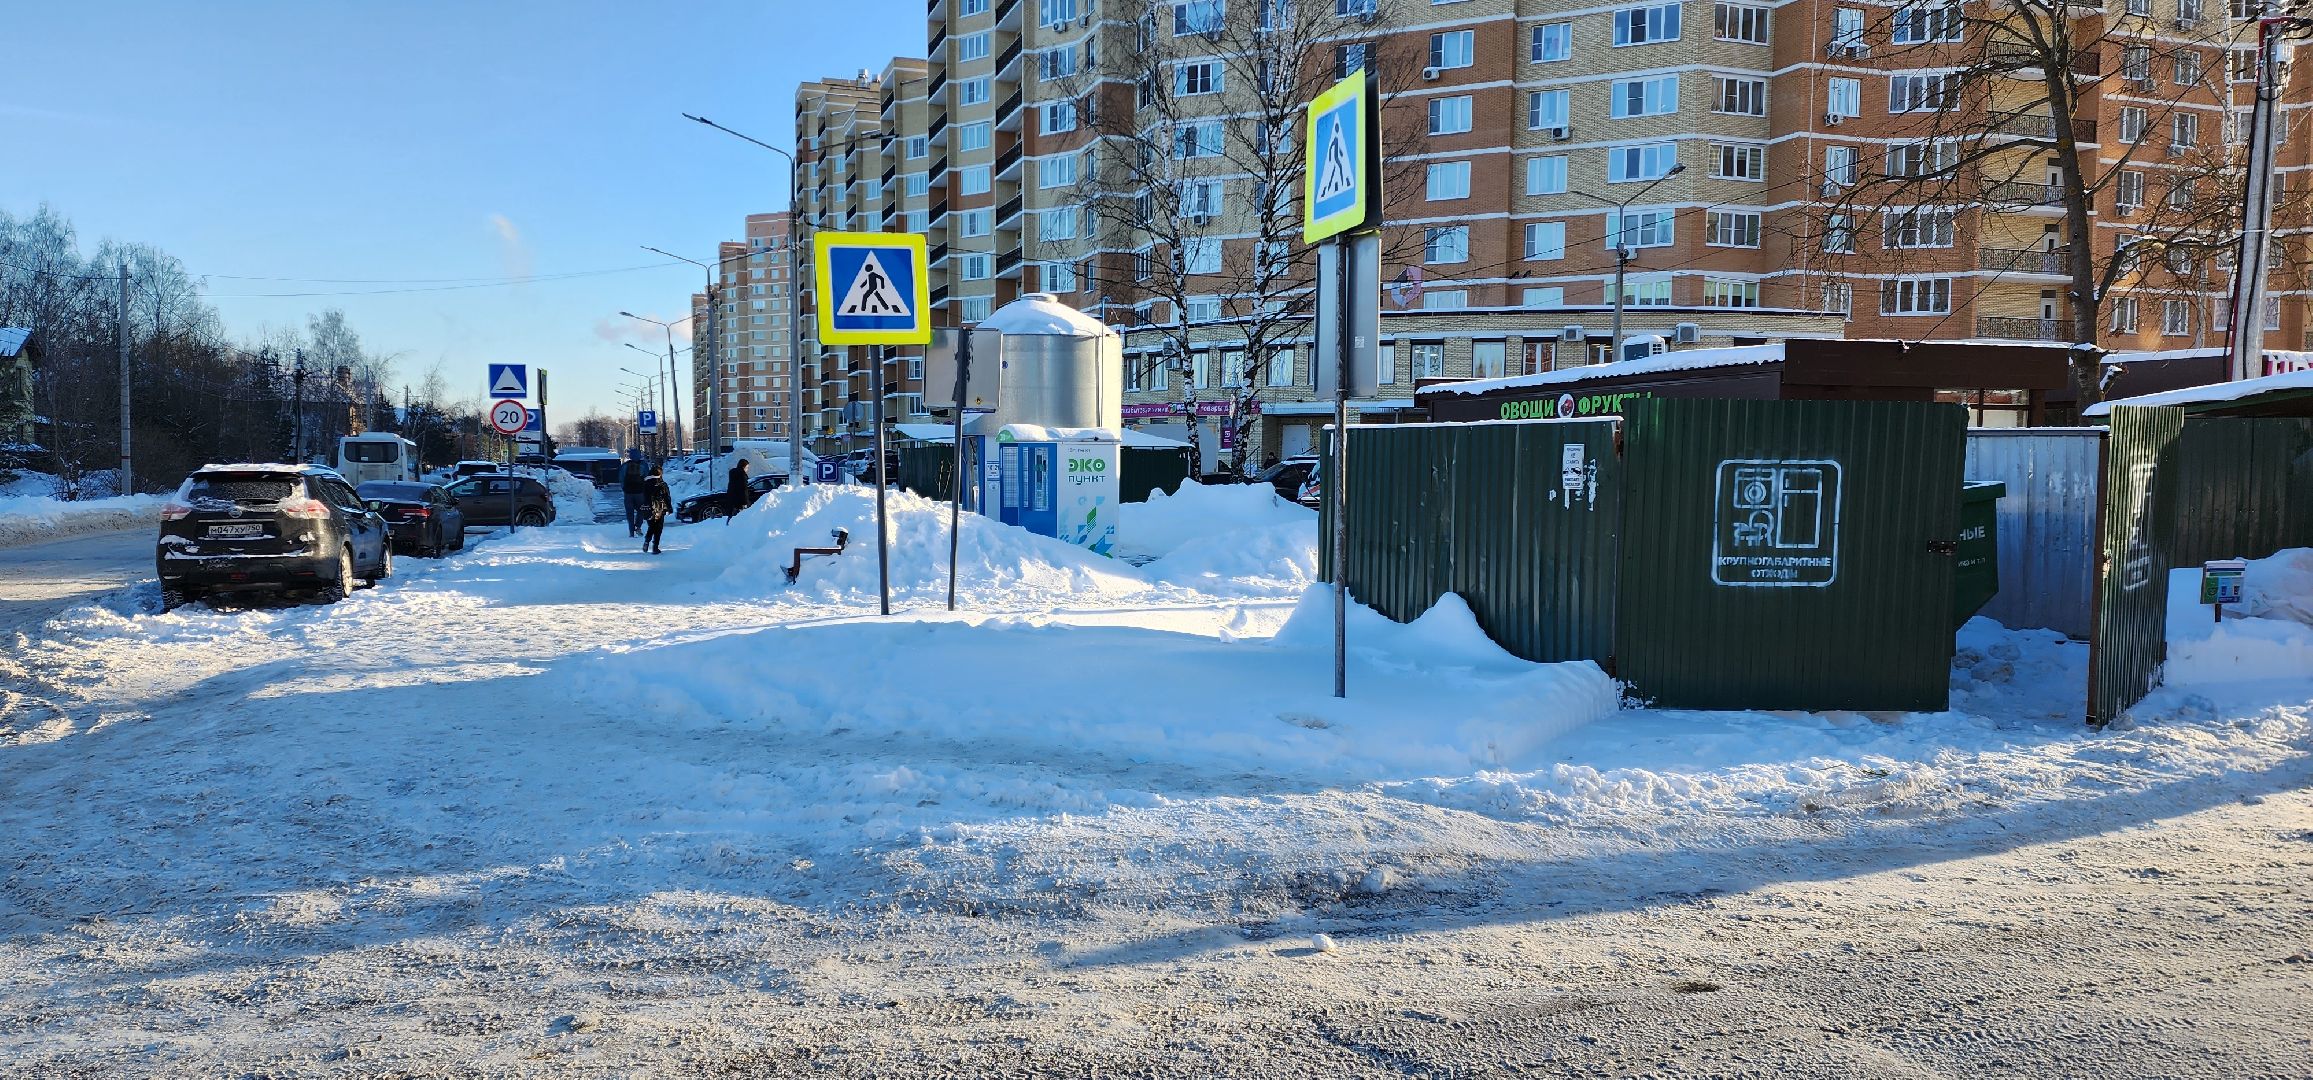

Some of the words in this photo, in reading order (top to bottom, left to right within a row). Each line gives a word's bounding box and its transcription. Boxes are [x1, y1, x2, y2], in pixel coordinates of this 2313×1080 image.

[1501, 399, 1554, 419] ОВОЩИ
[1578, 391, 1652, 415] ФРУК
[499, 410, 519, 424] 20
[642, 412, 652, 425] P
[822, 463, 834, 479] P
[1068, 458, 1106, 472] ЭКО
[1718, 556, 1832, 567] КРУПНОГАБАРИТНЫЕ
[1752, 569, 1798, 579] ОТХОДЫ
